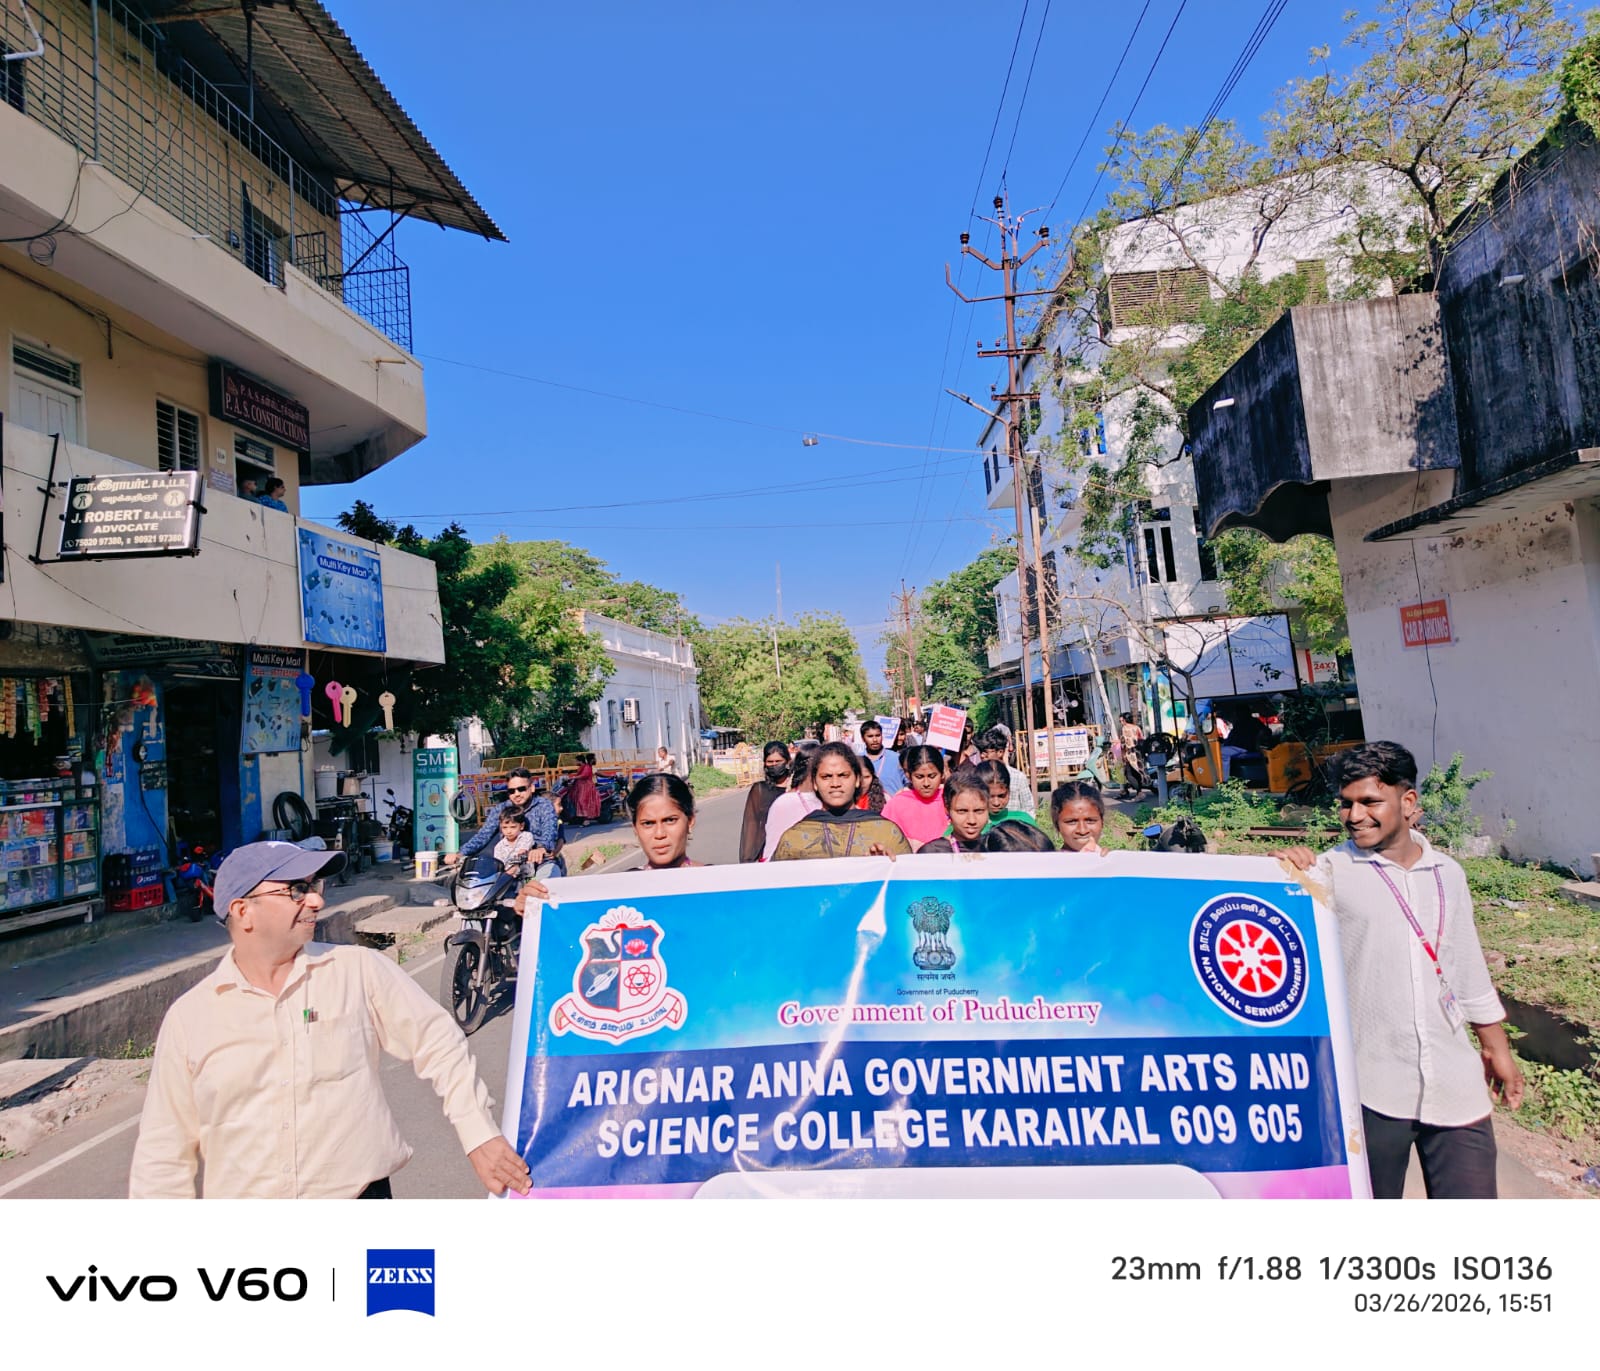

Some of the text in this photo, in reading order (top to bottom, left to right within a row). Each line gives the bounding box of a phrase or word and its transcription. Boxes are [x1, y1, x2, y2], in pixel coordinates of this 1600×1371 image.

[251, 404, 308, 444] CONSTRUCTIONS
[71, 513, 82, 524] J.
[84, 509, 143, 523] ROBERT
[93, 522, 159, 534] ADVOCATE
[319, 557, 337, 569] Multi
[337, 561, 351, 575] Key
[1404, 620, 1420, 642] CAR
[252, 651, 270, 664] Multi
[270, 653, 285, 667] Key
[416, 751, 455, 766] SMH
[1267, 915, 1298, 951] திட்டம்
[897, 988, 935, 996] Government
[944, 988, 979, 997] Puducherry
[1201, 956, 1301, 1017] NATIONAL SERVICE SCHEME
[779, 998, 1101, 1026] Govenment of Puducherry
[567, 1052, 1311, 1107] ARIGNAR ANNA GOVERNMENT ARTS AND
[597, 1103, 1303, 1158] SCIENCE COLLEGE KARAIKAL 609 605
